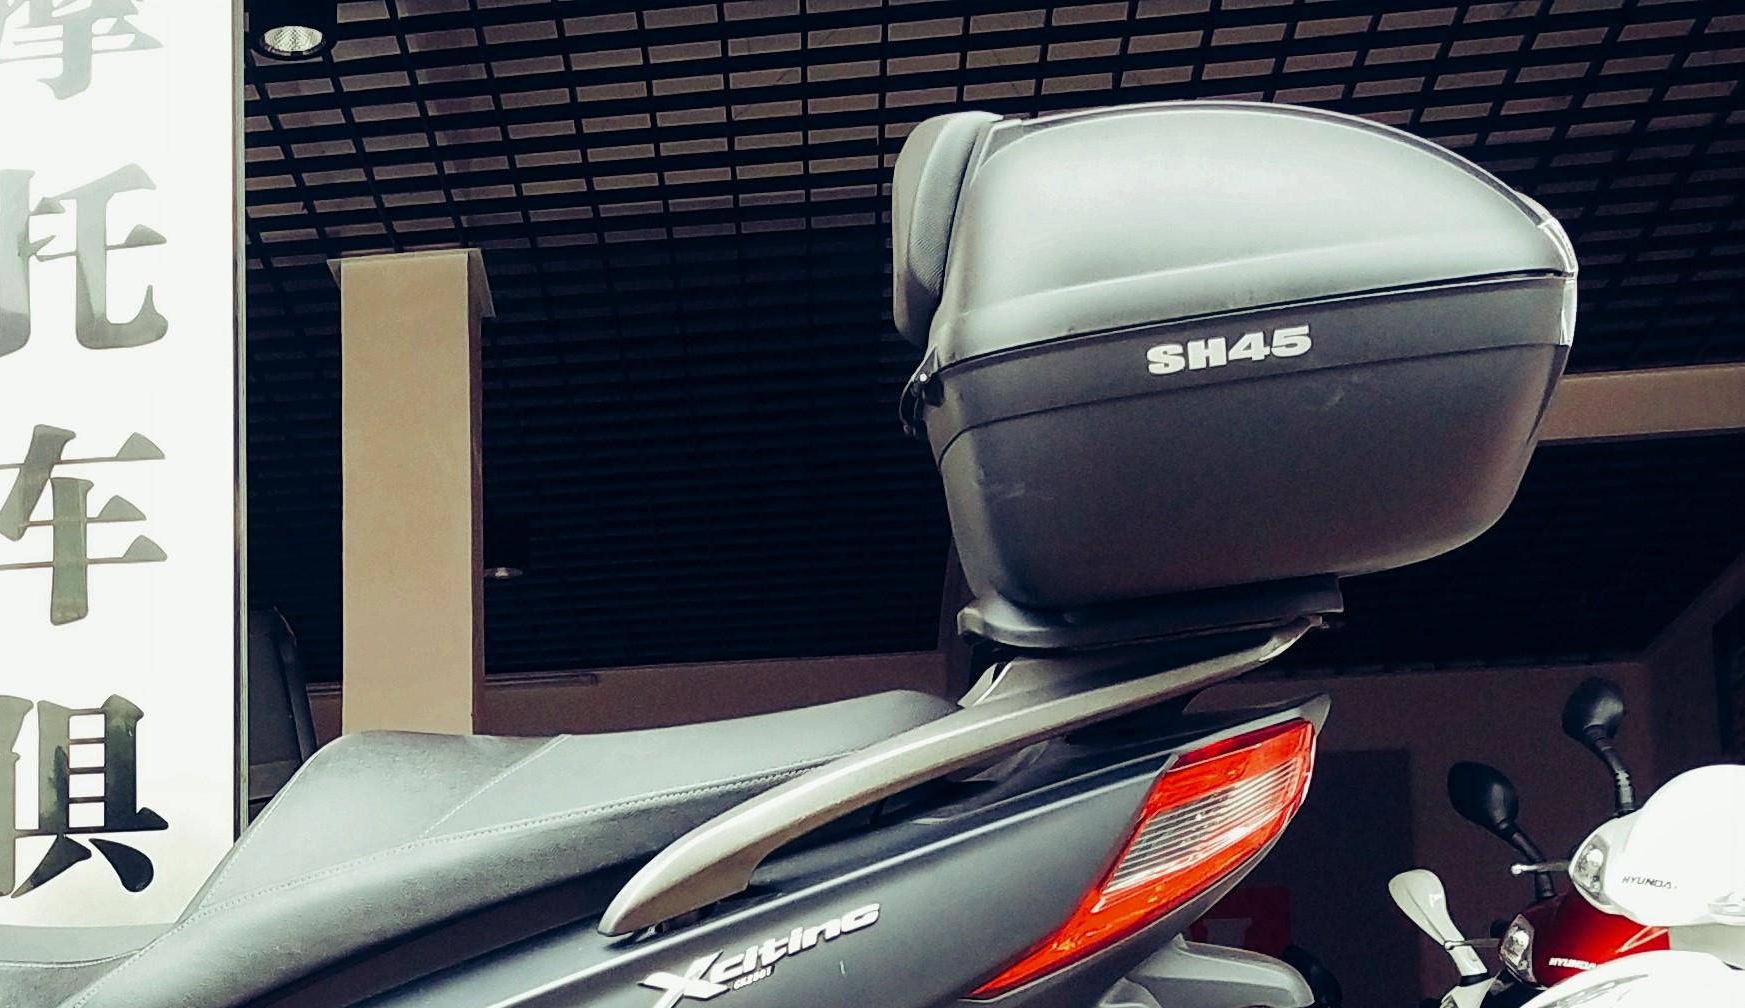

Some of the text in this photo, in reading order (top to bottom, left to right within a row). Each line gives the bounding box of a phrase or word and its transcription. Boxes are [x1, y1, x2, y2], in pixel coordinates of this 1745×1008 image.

[1146, 324, 1312, 375] SH45
[1621, 875, 1678, 890] HYUNDA
[1548, 957, 1597, 971] HYUNDA
